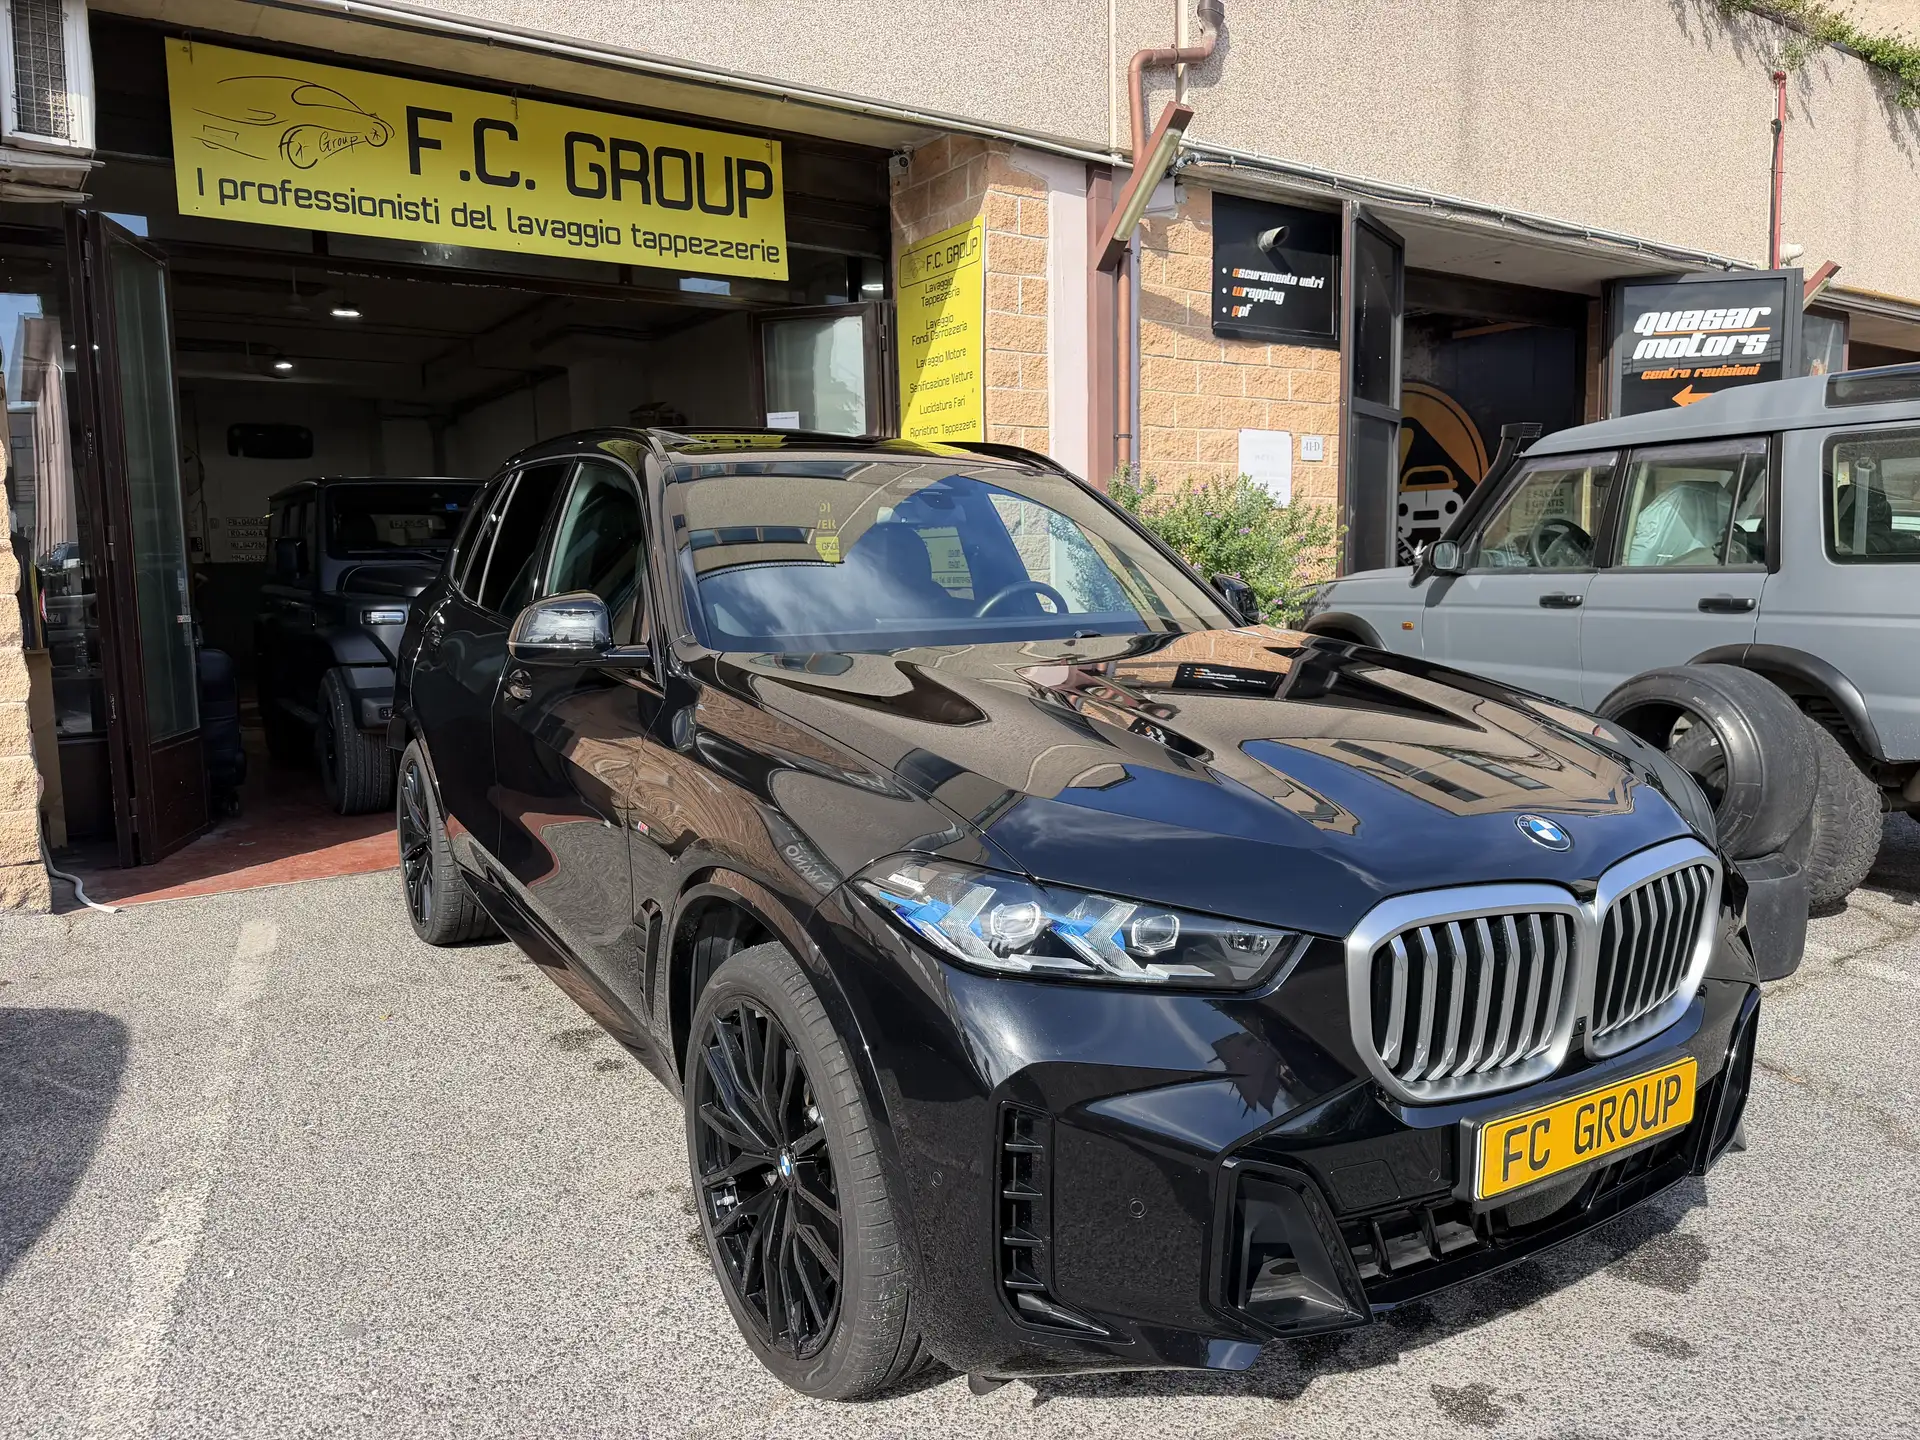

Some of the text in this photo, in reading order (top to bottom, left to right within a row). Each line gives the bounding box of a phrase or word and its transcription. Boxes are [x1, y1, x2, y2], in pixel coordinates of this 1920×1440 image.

[405, 105, 774, 219] F.C. GROUP
[196, 167, 780, 264] I professionisti del lavaggio tappezzerie
[926, 236, 978, 272] F.C. GROUP
[925, 276, 953, 294] Lavaggio
[1298, 275, 1325, 290] vetri
[921, 286, 961, 308] Tappezzeria
[1232, 286, 1285, 306] wrapping
[926, 313, 954, 331] Lavaggio
[1633, 306, 1772, 336] quasar
[912, 321, 968, 346] Fondi Carrozzeria
[1632, 332, 1771, 360] motors
[916, 347, 967, 369] Lavaggio Motore
[909, 370, 974, 394] Sanificazione Vetture
[1641, 363, 1761, 380] centro revisioni
[919, 394, 966, 415] Lucidatura Fari
[909, 418, 977, 440] Ripristino Tappezzeria
[1502, 1117, 1551, 1182] FC
[1573, 1074, 1682, 1155] GROUP
